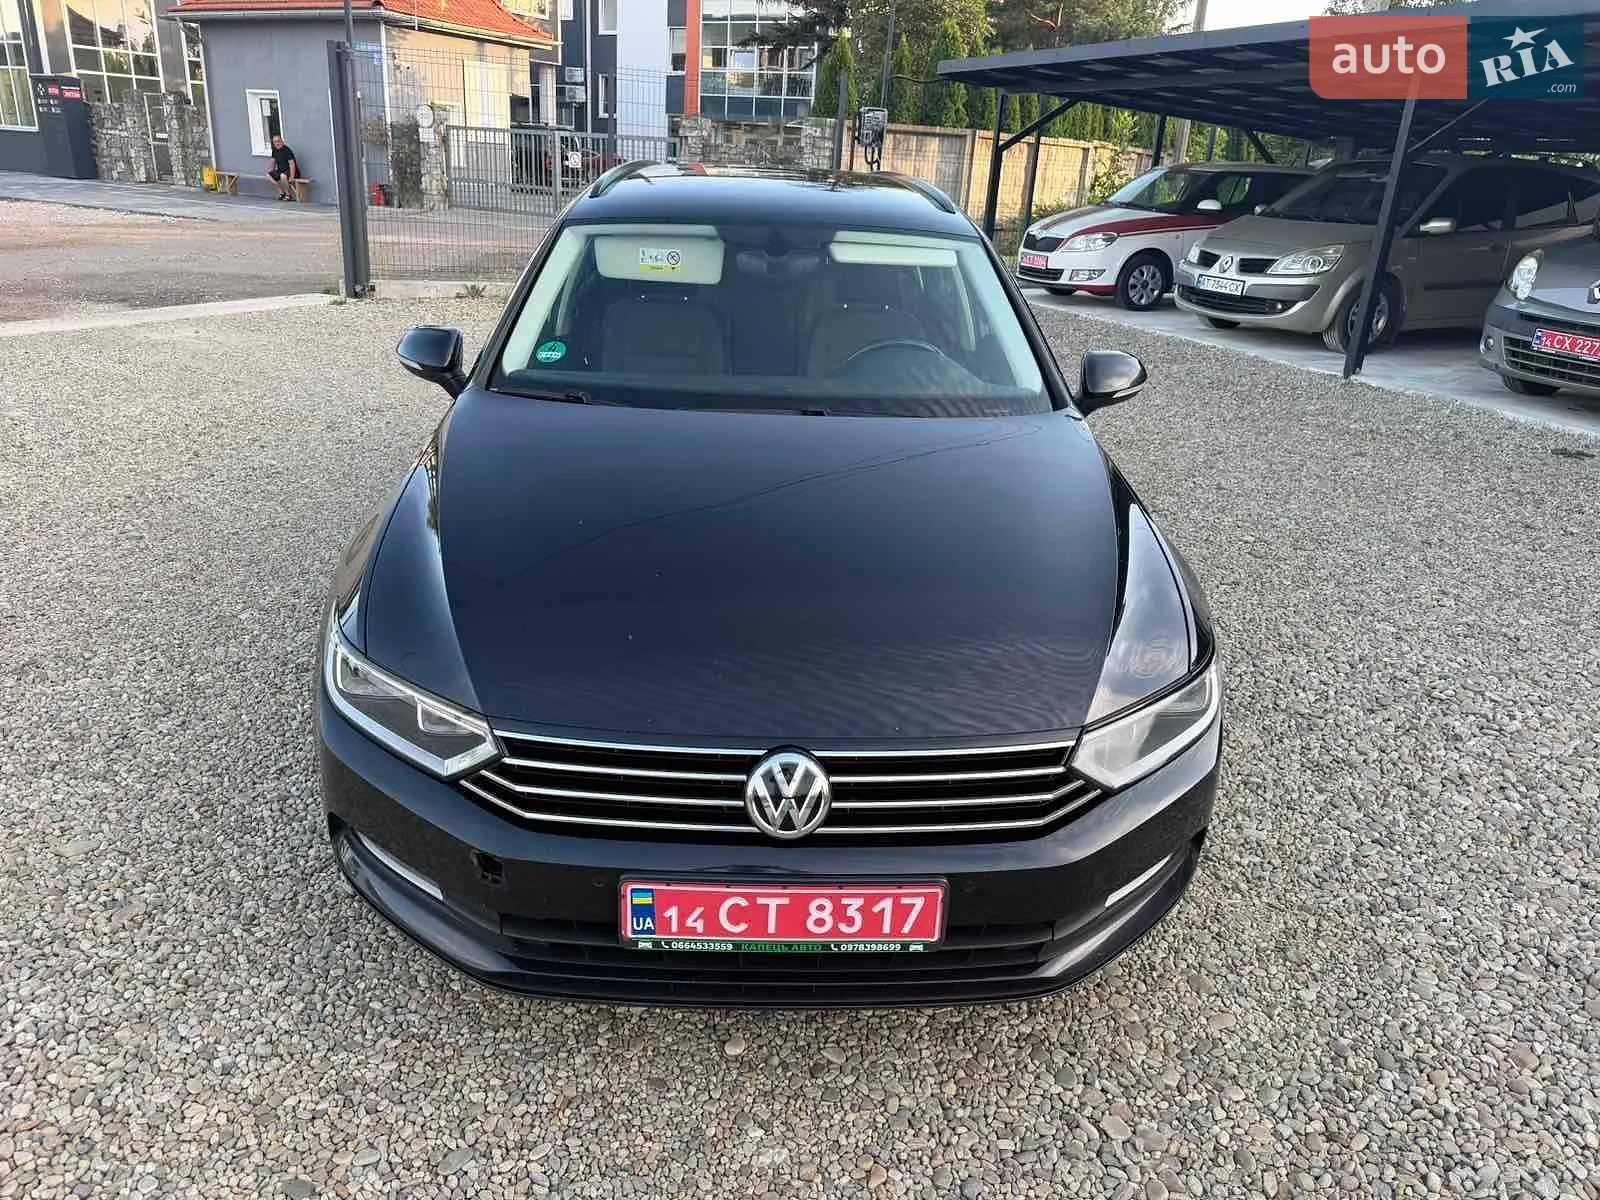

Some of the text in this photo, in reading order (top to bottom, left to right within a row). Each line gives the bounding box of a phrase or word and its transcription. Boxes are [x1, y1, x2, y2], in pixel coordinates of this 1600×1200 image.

[1541, 335, 1600, 355] 14 CX 227
[633, 896, 926, 935] UA 14 CT 8317
[671, 941, 734, 951] 0664533559
